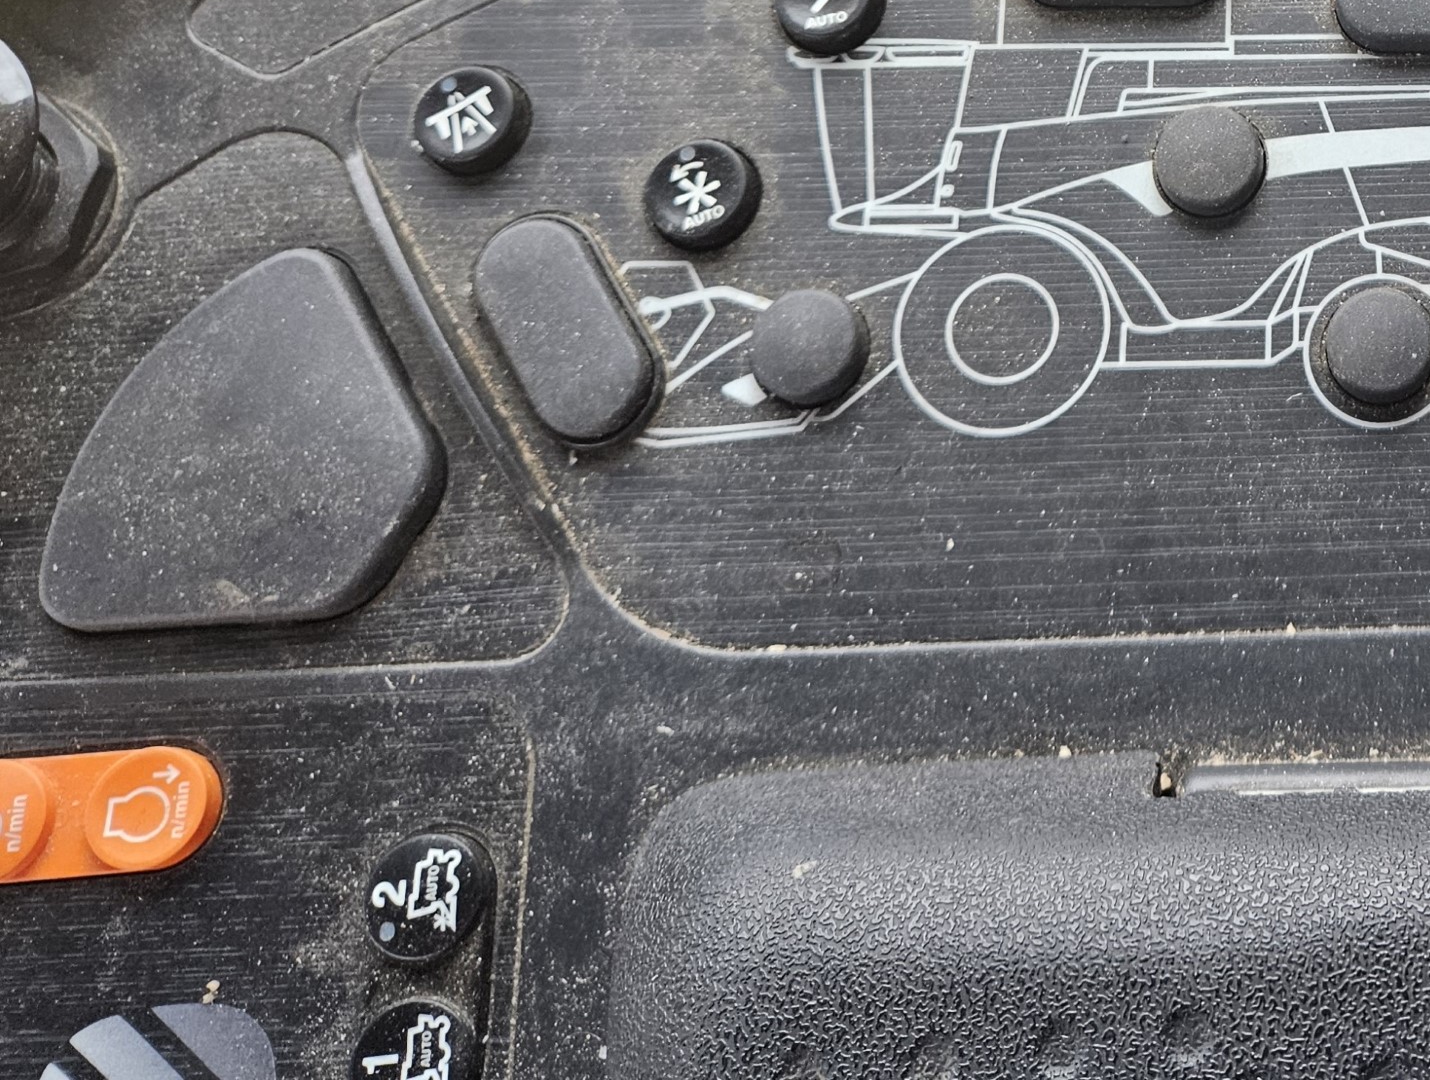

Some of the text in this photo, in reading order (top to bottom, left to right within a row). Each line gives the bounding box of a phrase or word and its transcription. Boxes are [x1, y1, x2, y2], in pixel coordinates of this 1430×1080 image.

[803, 10, 849, 31] AUTO
[681, 204, 726, 233] AUTO
[6, 793, 29, 854] n/min
[169, 780, 191, 840] n/min
[371, 879, 407, 909] 2
[424, 864, 441, 901] AUTO
[361, 1053, 399, 1075] 1
[420, 1029, 433, 1068] AUTO
